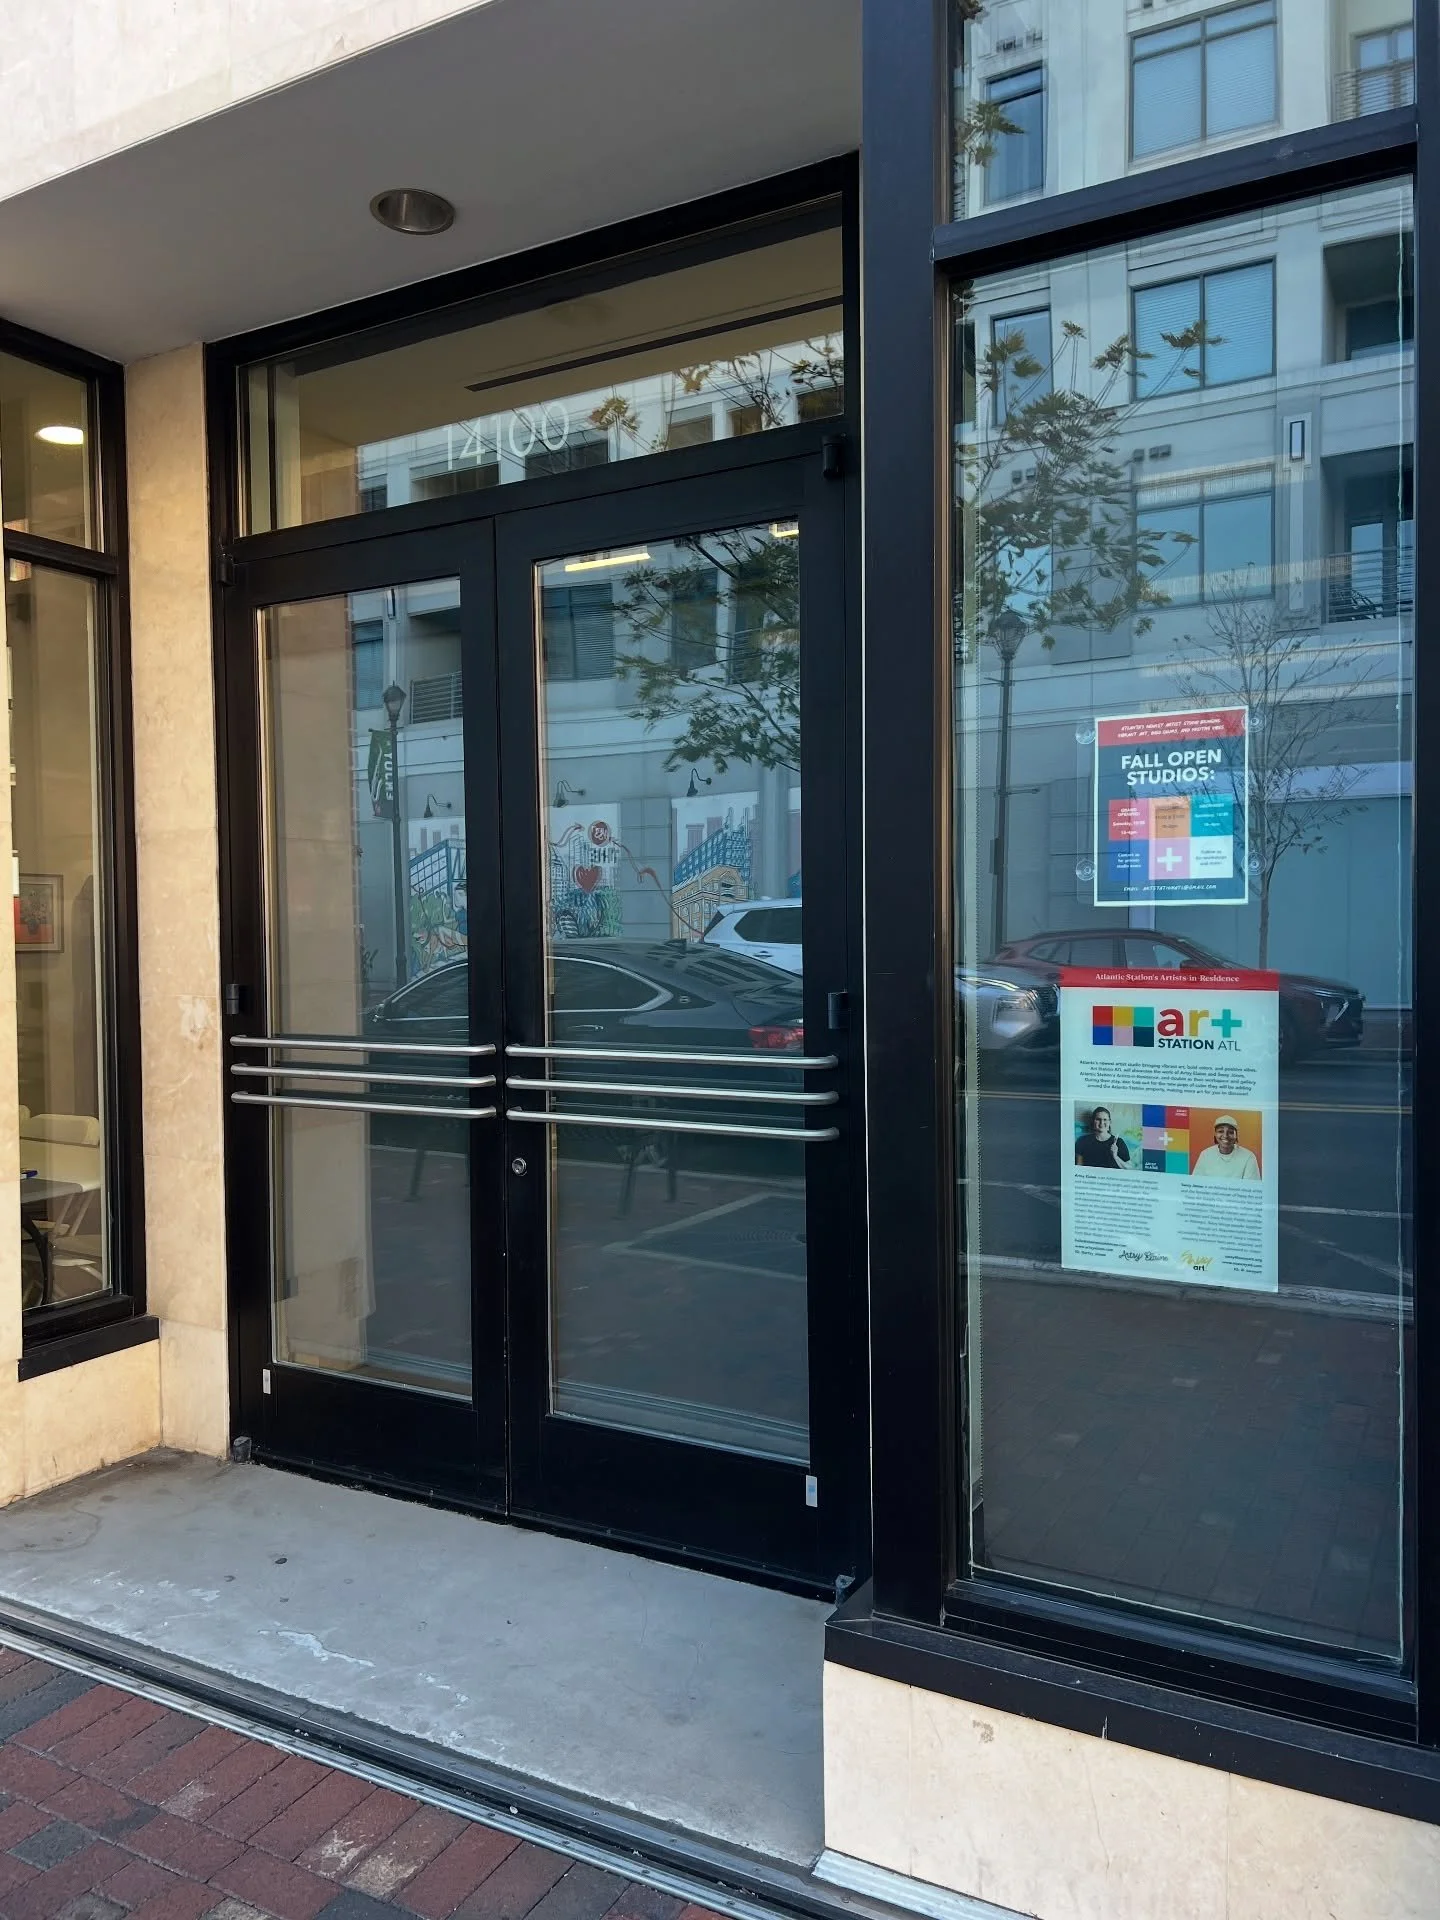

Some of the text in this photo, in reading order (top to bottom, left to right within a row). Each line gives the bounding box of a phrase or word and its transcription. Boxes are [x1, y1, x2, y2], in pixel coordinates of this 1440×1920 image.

[442, 401, 570, 471] 14100
[1121, 749, 1222, 769] FALL OPEN
[1127, 766, 1215, 786] STUDIOS:
[1095, 973, 1125, 981] Atlantic
[1125, 973, 1159, 982] Station's
[1158, 1038, 1241, 1051] STATION ATL
